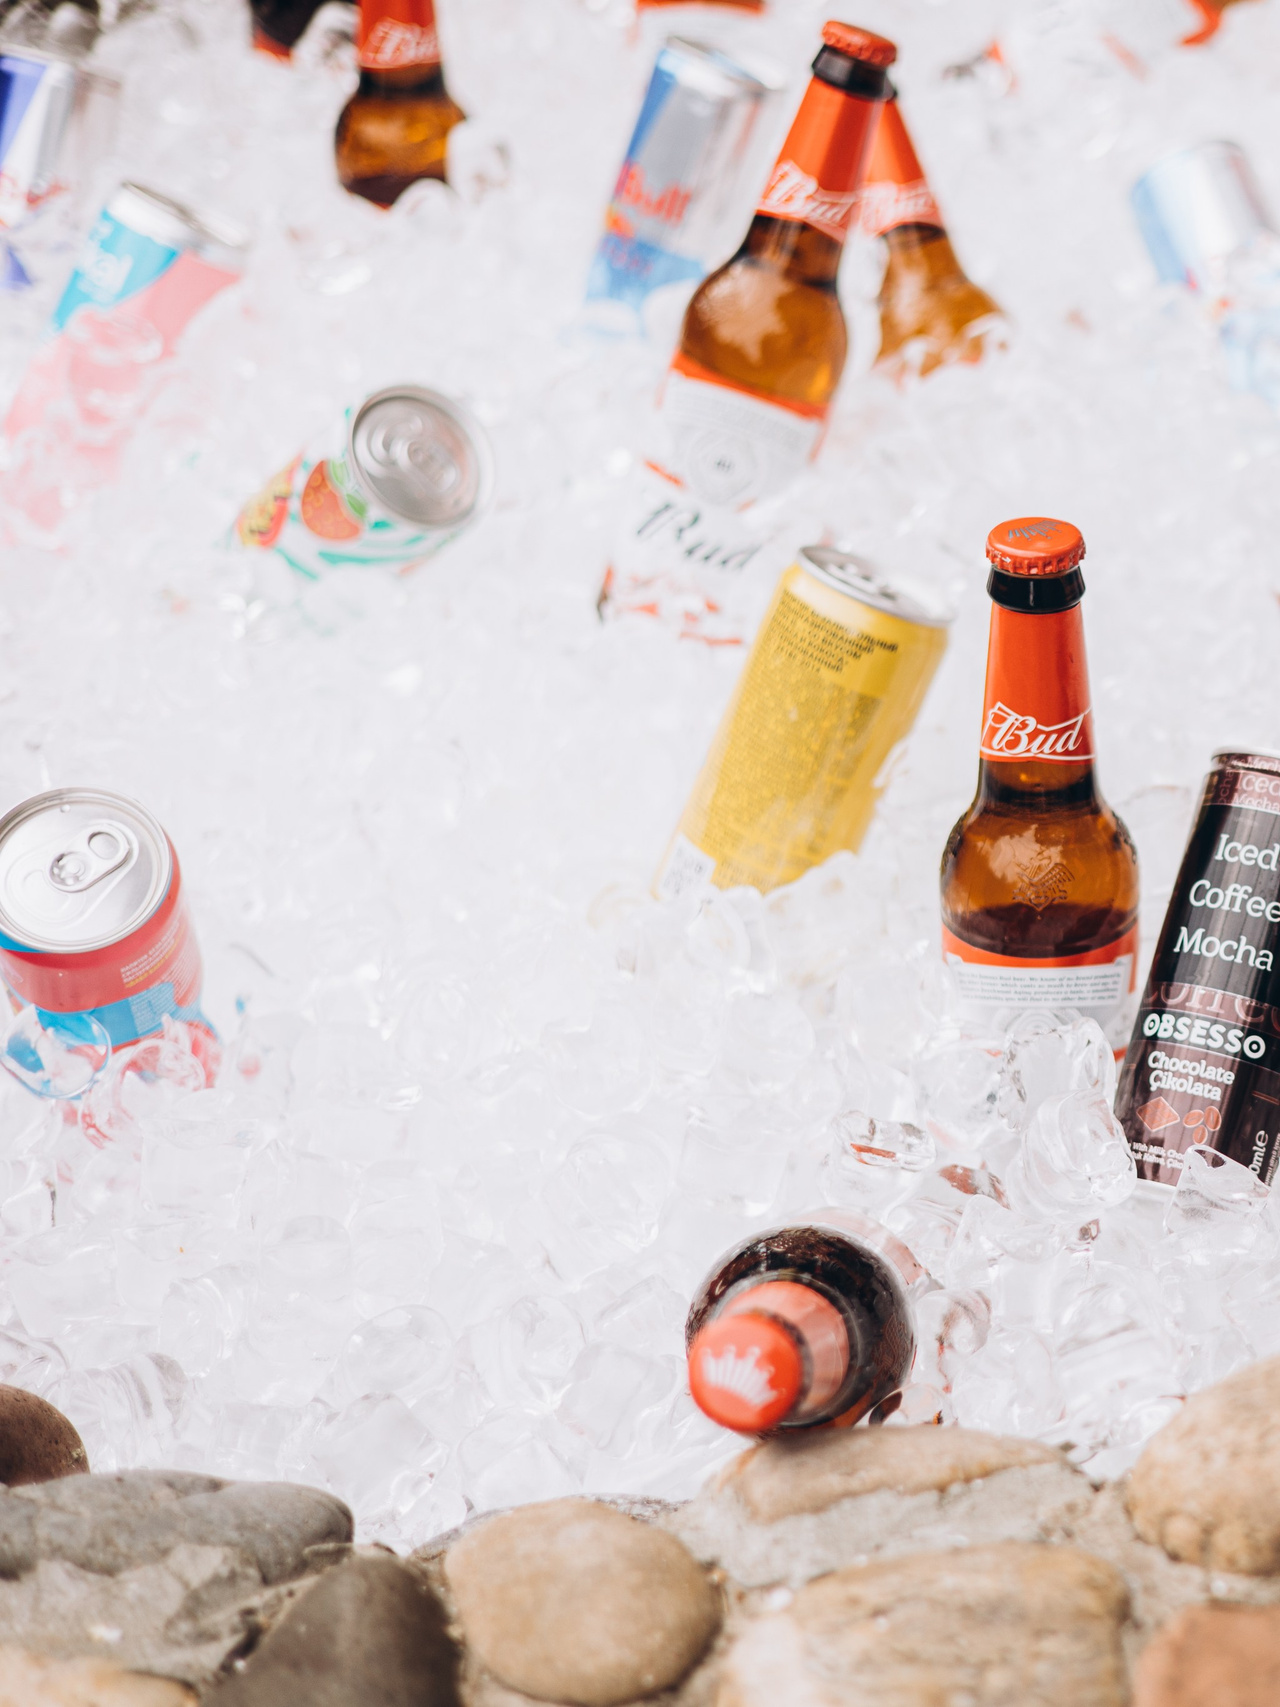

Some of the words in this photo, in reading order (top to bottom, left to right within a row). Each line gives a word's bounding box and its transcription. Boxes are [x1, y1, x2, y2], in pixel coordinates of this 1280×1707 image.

[988, 710, 1084, 756] Bud
[1215, 833, 1280, 871] Iced
[1173, 926, 1274, 972] Mocha
[1143, 1013, 1266, 1060] OBSESSO
[1148, 1051, 1235, 1085] Chocolate
[1149, 1070, 1222, 1101] Çikolata
[1132, 1142, 1148, 1152] With
[1148, 1144, 1166, 1156] Milk,
[1143, 1152, 1165, 1166] Kahve,
